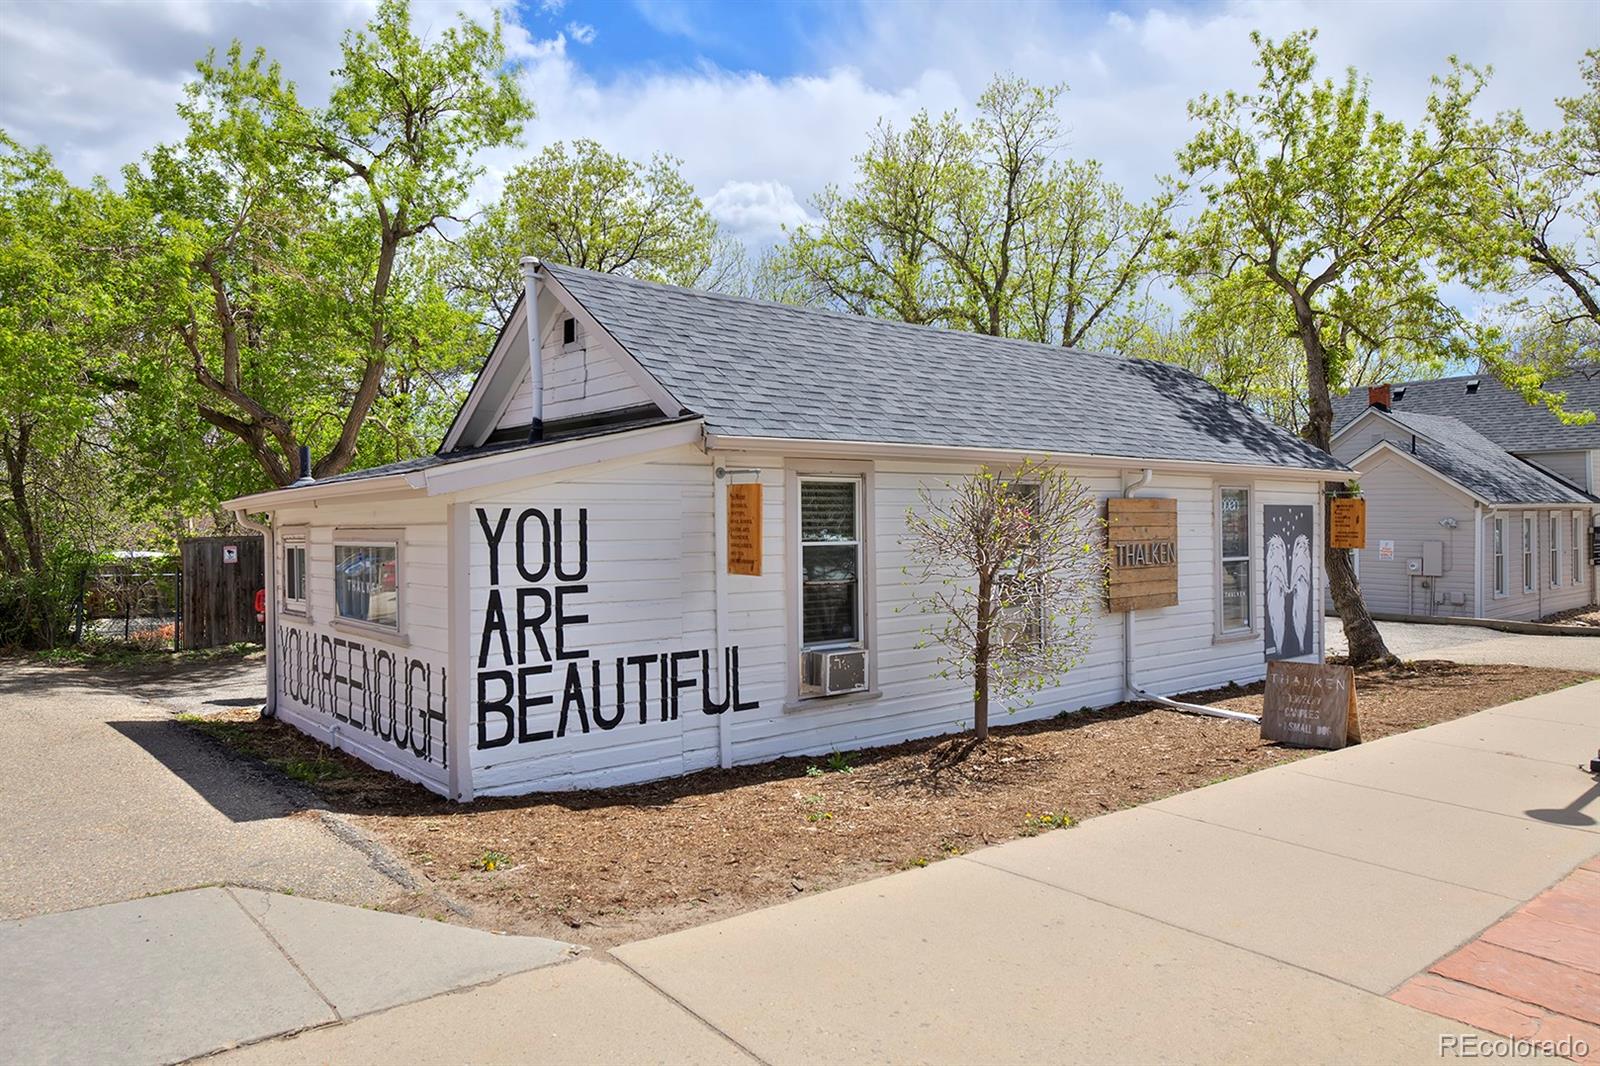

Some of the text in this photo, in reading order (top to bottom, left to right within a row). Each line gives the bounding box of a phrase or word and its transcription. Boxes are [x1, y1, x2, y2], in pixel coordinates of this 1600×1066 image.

[475, 508, 588, 585] YOU
[1116, 542, 1177, 566] THALKEN
[478, 584, 590, 668] ARE
[477, 646, 760, 750] BEAUTIFUL
